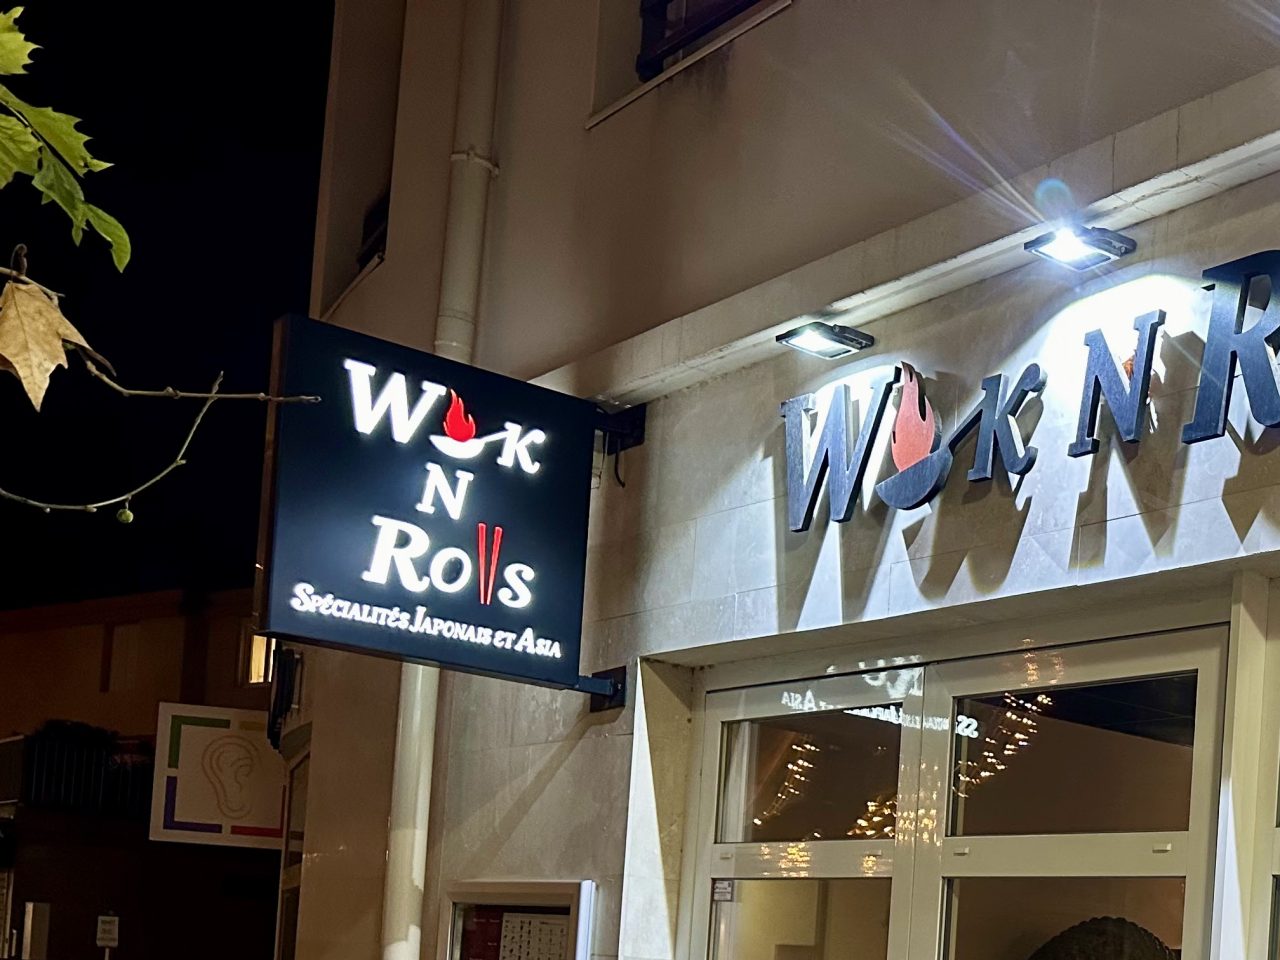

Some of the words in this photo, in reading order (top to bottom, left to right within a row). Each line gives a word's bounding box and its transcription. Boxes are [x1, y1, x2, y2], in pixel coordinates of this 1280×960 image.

[1067, 309, 1167, 458] N
[415, 462, 475, 520] N
[409, 605, 492, 645] JAPONAIS
[494, 630, 517, 650] ET
[515, 627, 562, 658] ASIA
